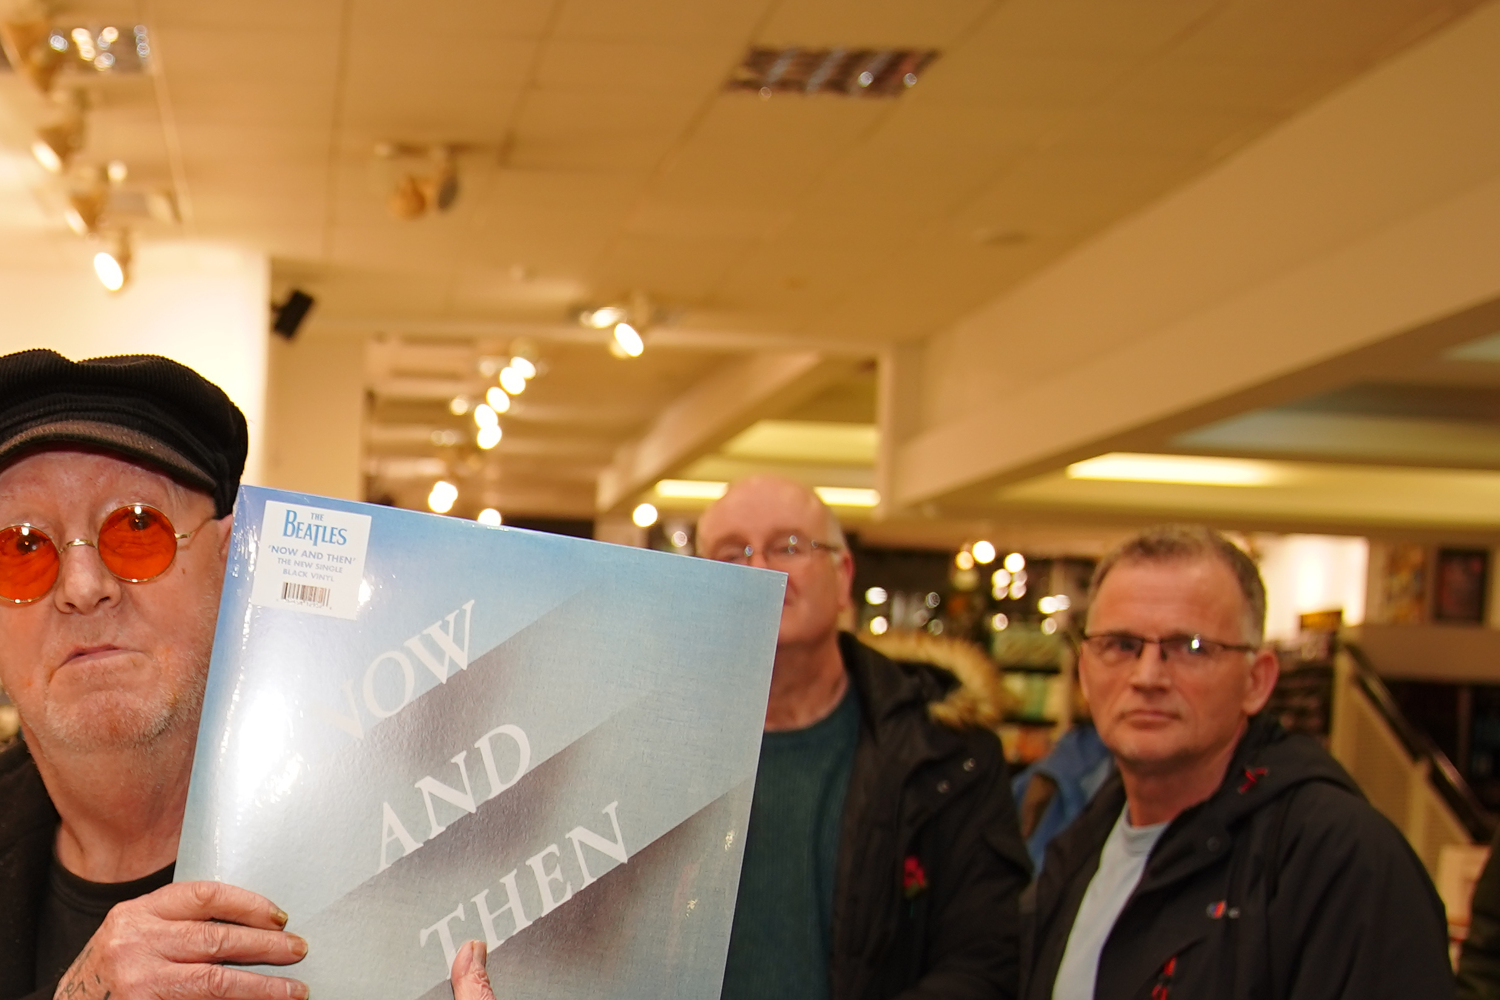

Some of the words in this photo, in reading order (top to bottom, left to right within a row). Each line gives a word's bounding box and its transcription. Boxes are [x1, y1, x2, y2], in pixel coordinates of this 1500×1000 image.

[282, 509, 348, 547] BEATLES
[310, 512, 325, 522] THE
[277, 557, 292, 566] THE
[294, 560, 313, 569] NEW
[315, 563, 343, 574] SINGLE
[301, 549, 324, 560] AND
[282, 568, 308, 578] BLACK
[311, 572, 335, 582] VINYL
[312, 600, 475, 740] NOW
[376, 722, 531, 874] AND
[419, 801, 629, 980] THEN
